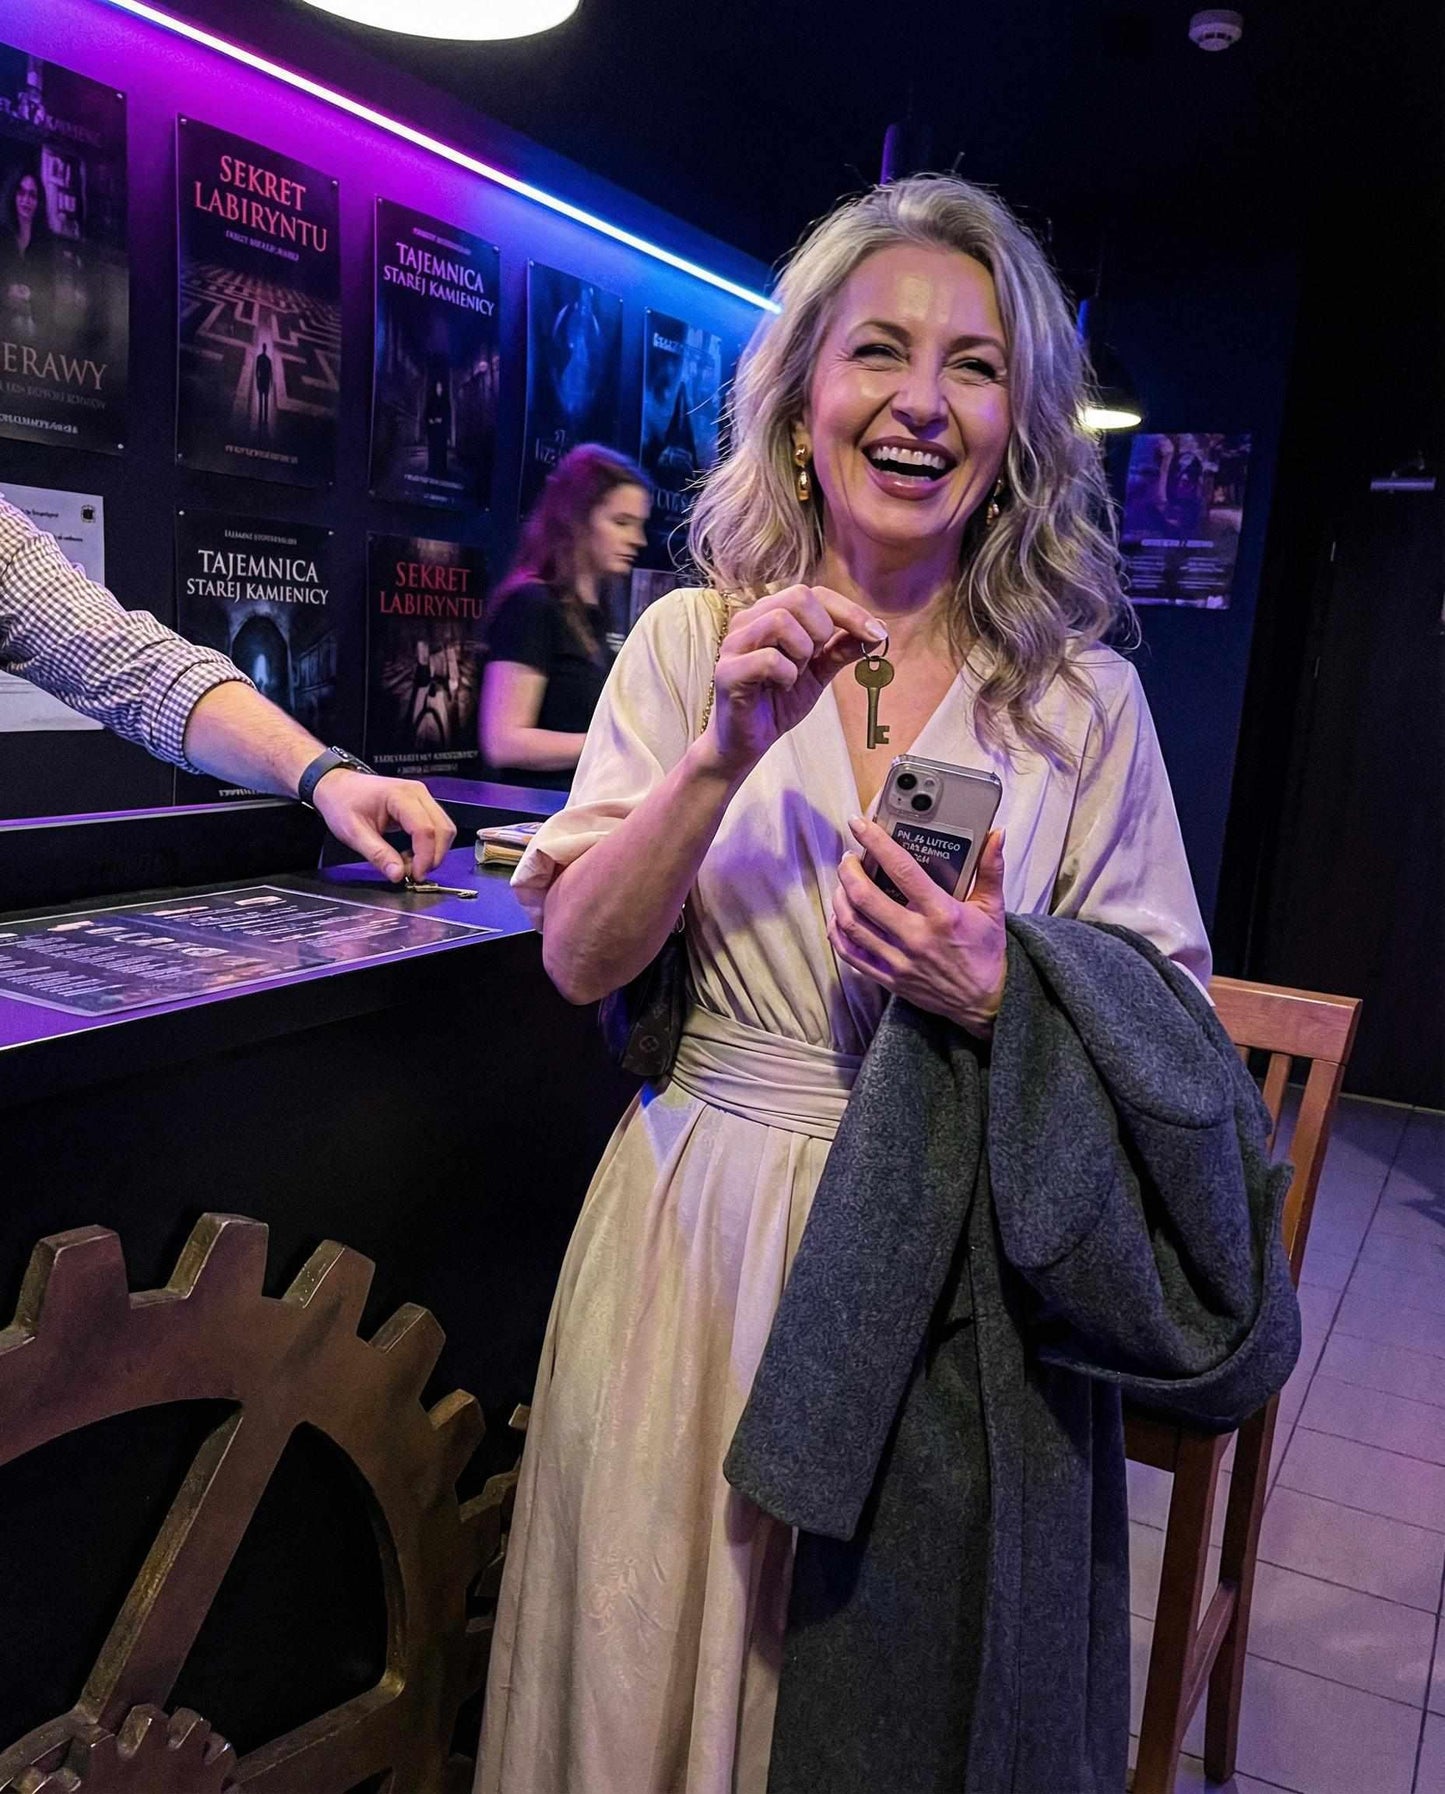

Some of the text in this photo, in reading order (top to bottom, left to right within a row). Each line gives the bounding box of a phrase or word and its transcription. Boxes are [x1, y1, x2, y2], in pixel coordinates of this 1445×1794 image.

[220, 155, 307, 212] SEKRET
[194, 181, 327, 252] LABIRYNTU
[395, 241, 484, 294] TAJEMNICA
[383, 264, 496, 317] STAREJ KAMIENICY
[3, 341, 108, 390] ERAWY
[198, 549, 319, 583] TAJEMNICA
[395, 561, 472, 593] SEKRET
[186, 577, 329, 605] STAREJ KAMIENICY
[380, 590, 483, 619] LABIRYNTU
[926, 836, 961, 851] LUTEGO
